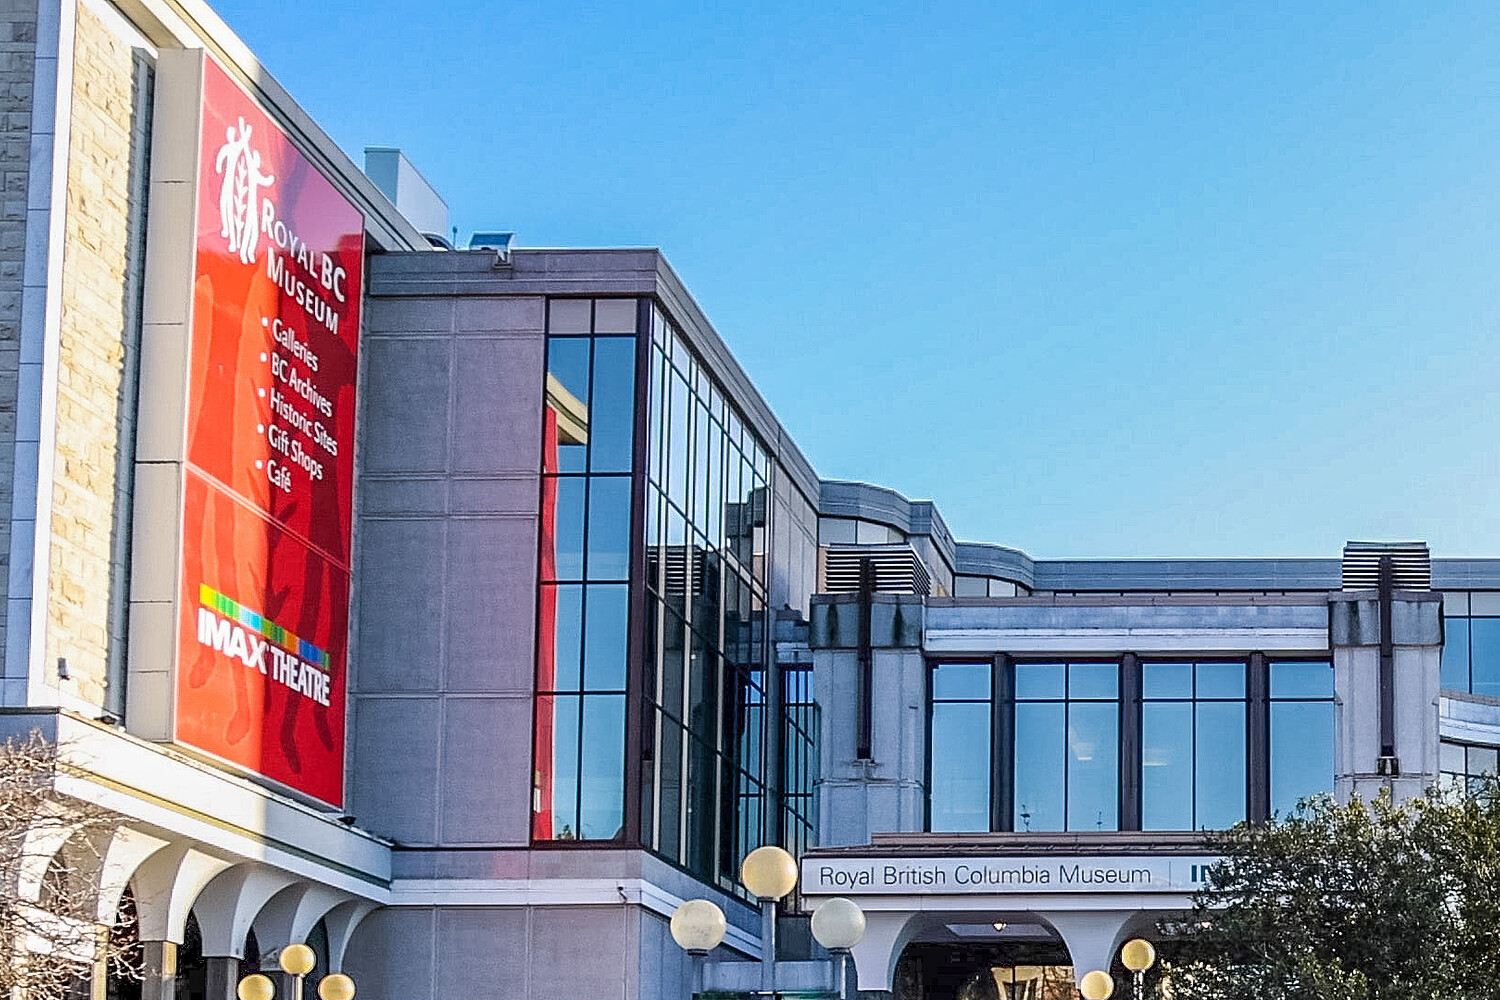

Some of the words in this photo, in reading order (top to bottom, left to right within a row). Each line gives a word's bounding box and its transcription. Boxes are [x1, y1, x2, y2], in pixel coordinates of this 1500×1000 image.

[262, 198, 318, 279] ROYAL
[321, 252, 346, 302] BC
[267, 247, 338, 335] MUSEUM
[272, 319, 318, 372] Galleries
[271, 352, 288, 383] BC
[289, 367, 332, 417] Archives
[268, 424, 289, 456] Gift
[291, 440, 323, 481] Shops
[270, 387, 312, 437] Historic
[313, 421, 338, 456] Sites
[267, 459, 291, 493] Café
[198, 608, 268, 675] IMAX
[271, 645, 331, 707] THEATRE
[820, 865, 874, 889] Royal
[884, 864, 946, 884] British
[954, 864, 1051, 884] Columbia
[1059, 864, 1152, 884] Museum
